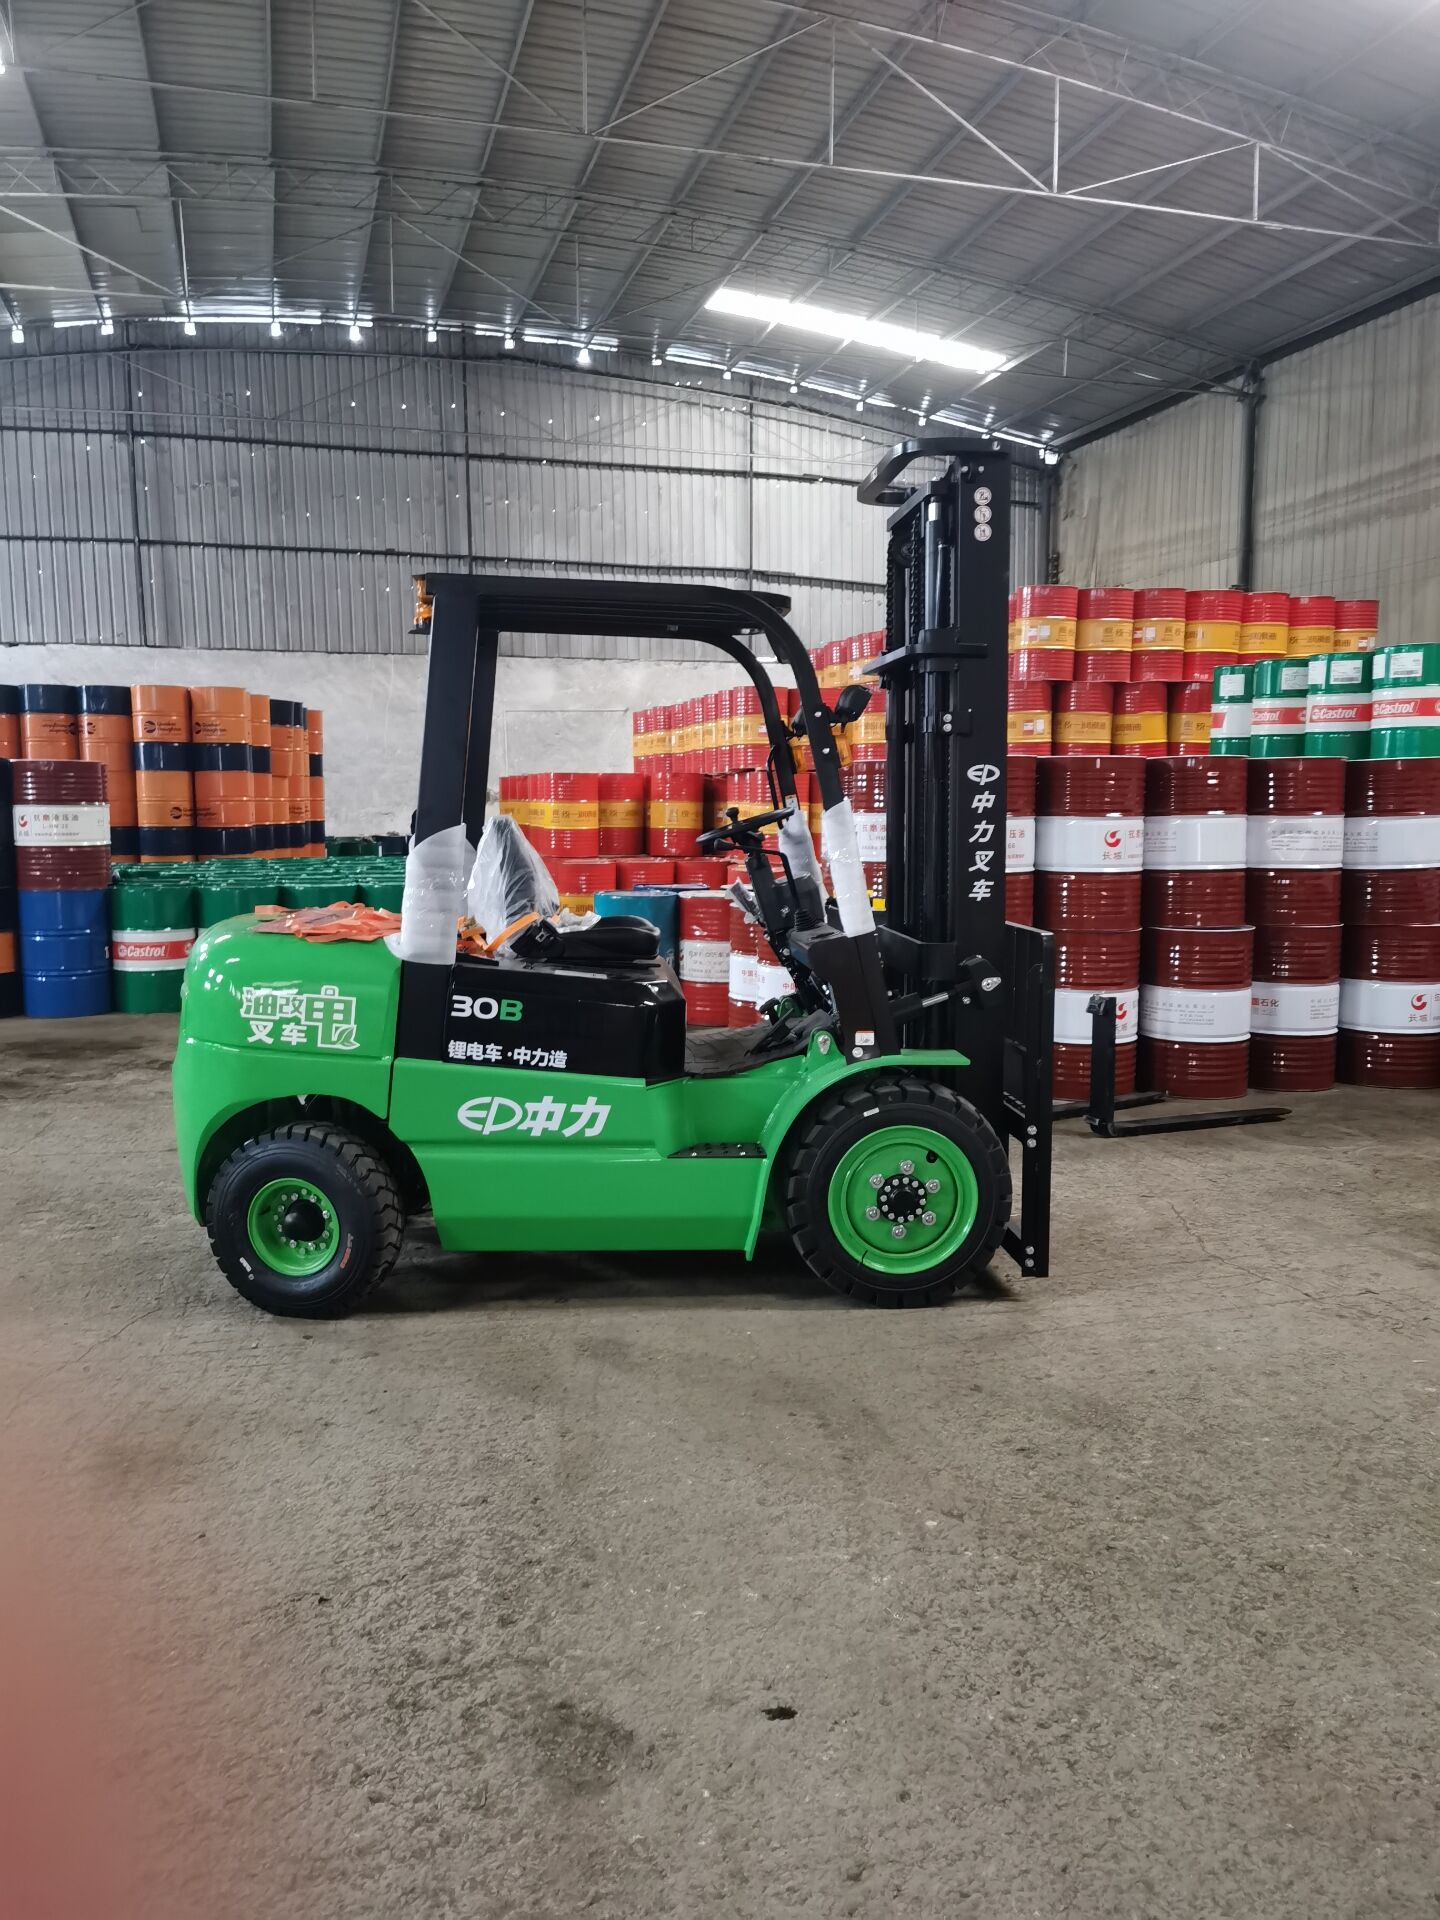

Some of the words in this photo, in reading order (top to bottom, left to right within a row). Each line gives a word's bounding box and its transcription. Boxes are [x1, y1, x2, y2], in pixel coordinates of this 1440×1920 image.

[1320, 708, 1357, 719] Castrol
[1379, 702, 1414, 715] Castrol
[968, 791, 996, 902] 中力叉车
[127, 945, 166, 957] Castrol
[451, 994, 524, 1022] 30B
[247, 1020, 307, 1045] 叉车
[516, 1095, 611, 1137] 中力
